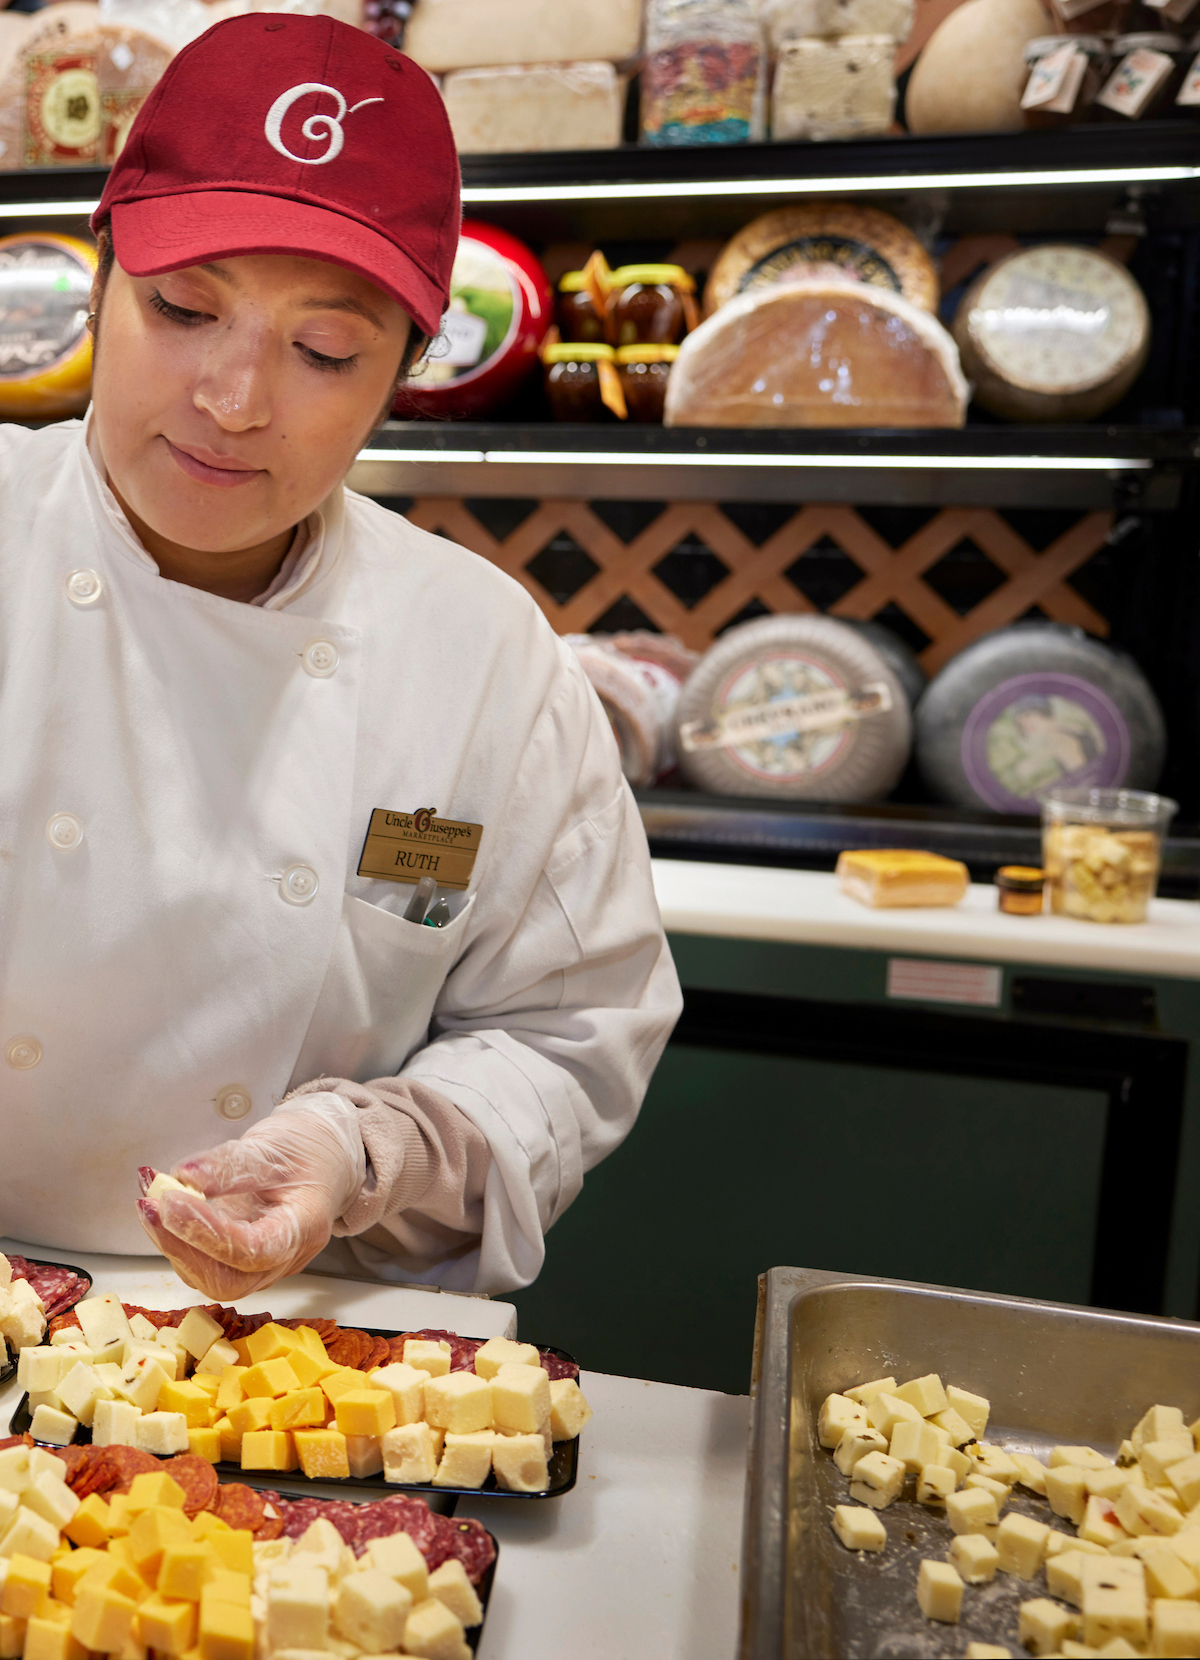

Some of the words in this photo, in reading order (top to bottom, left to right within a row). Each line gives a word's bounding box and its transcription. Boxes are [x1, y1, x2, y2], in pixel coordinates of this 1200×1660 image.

[385, 813, 412, 829] Uncle
[414, 809, 472, 838] Giuseppe's
[402, 830, 455, 844] MARKETPLACE
[394, 850, 441, 871] RUTH
